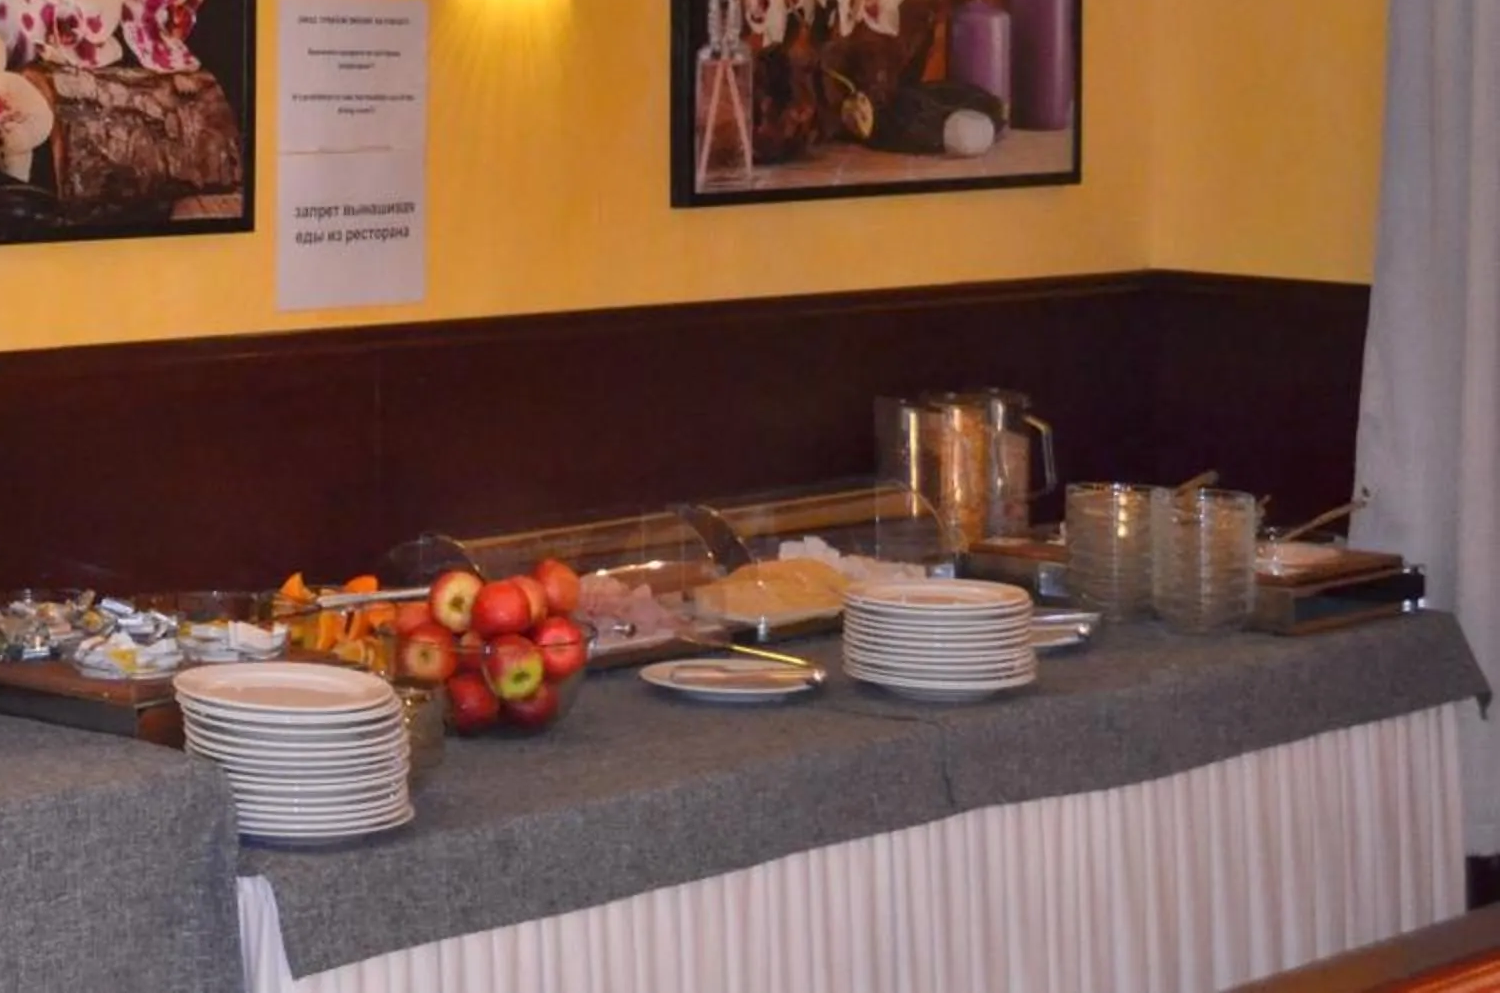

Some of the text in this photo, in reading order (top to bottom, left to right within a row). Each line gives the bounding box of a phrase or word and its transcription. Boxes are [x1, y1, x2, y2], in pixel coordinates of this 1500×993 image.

[294, 206, 339, 221] запрет
[296, 227, 410, 245] еды из ресторана
